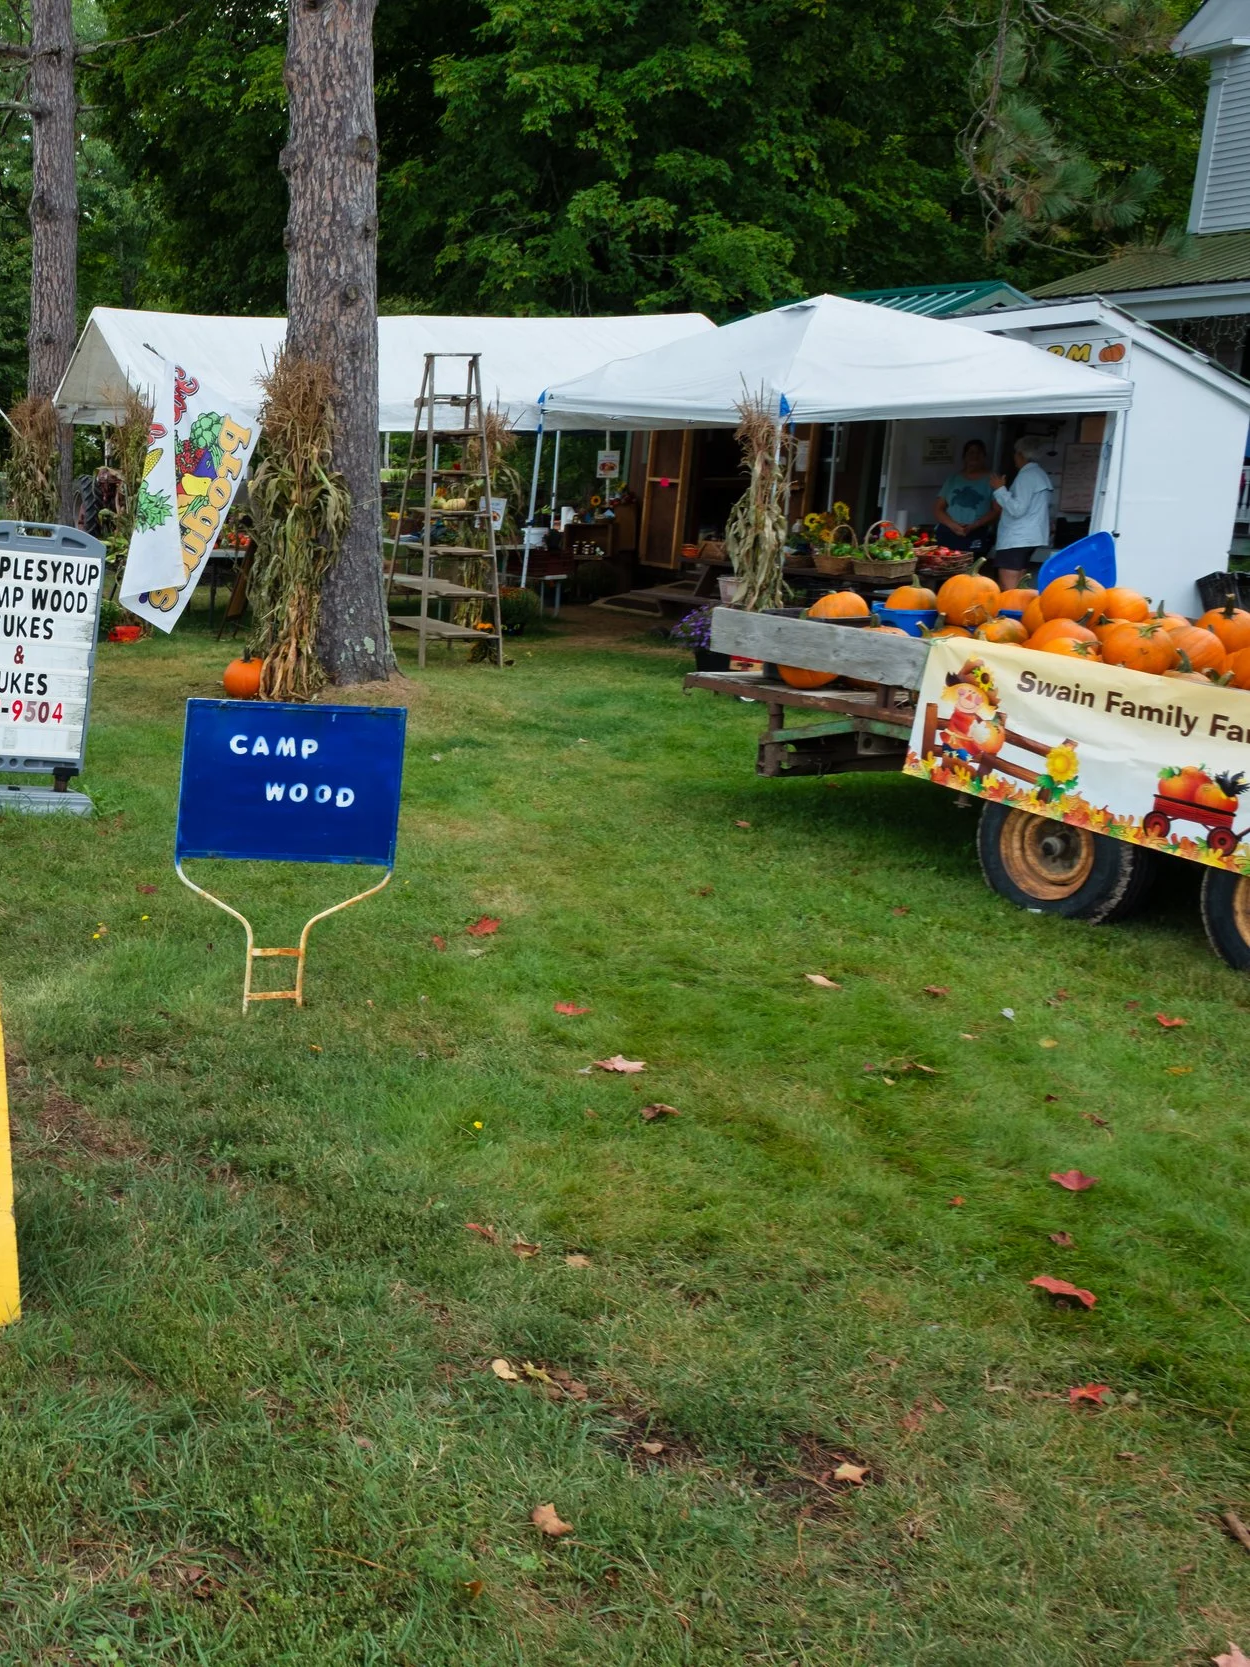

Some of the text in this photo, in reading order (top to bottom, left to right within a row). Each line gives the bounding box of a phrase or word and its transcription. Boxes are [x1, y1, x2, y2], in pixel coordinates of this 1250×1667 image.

[31, 588, 88, 613] WOOD
[13, 644, 25, 665] &
[1016, 670, 1250, 744] Swain Family Fa
[229, 734, 319, 760] CAMP
[265, 781, 356, 808] WOOD
